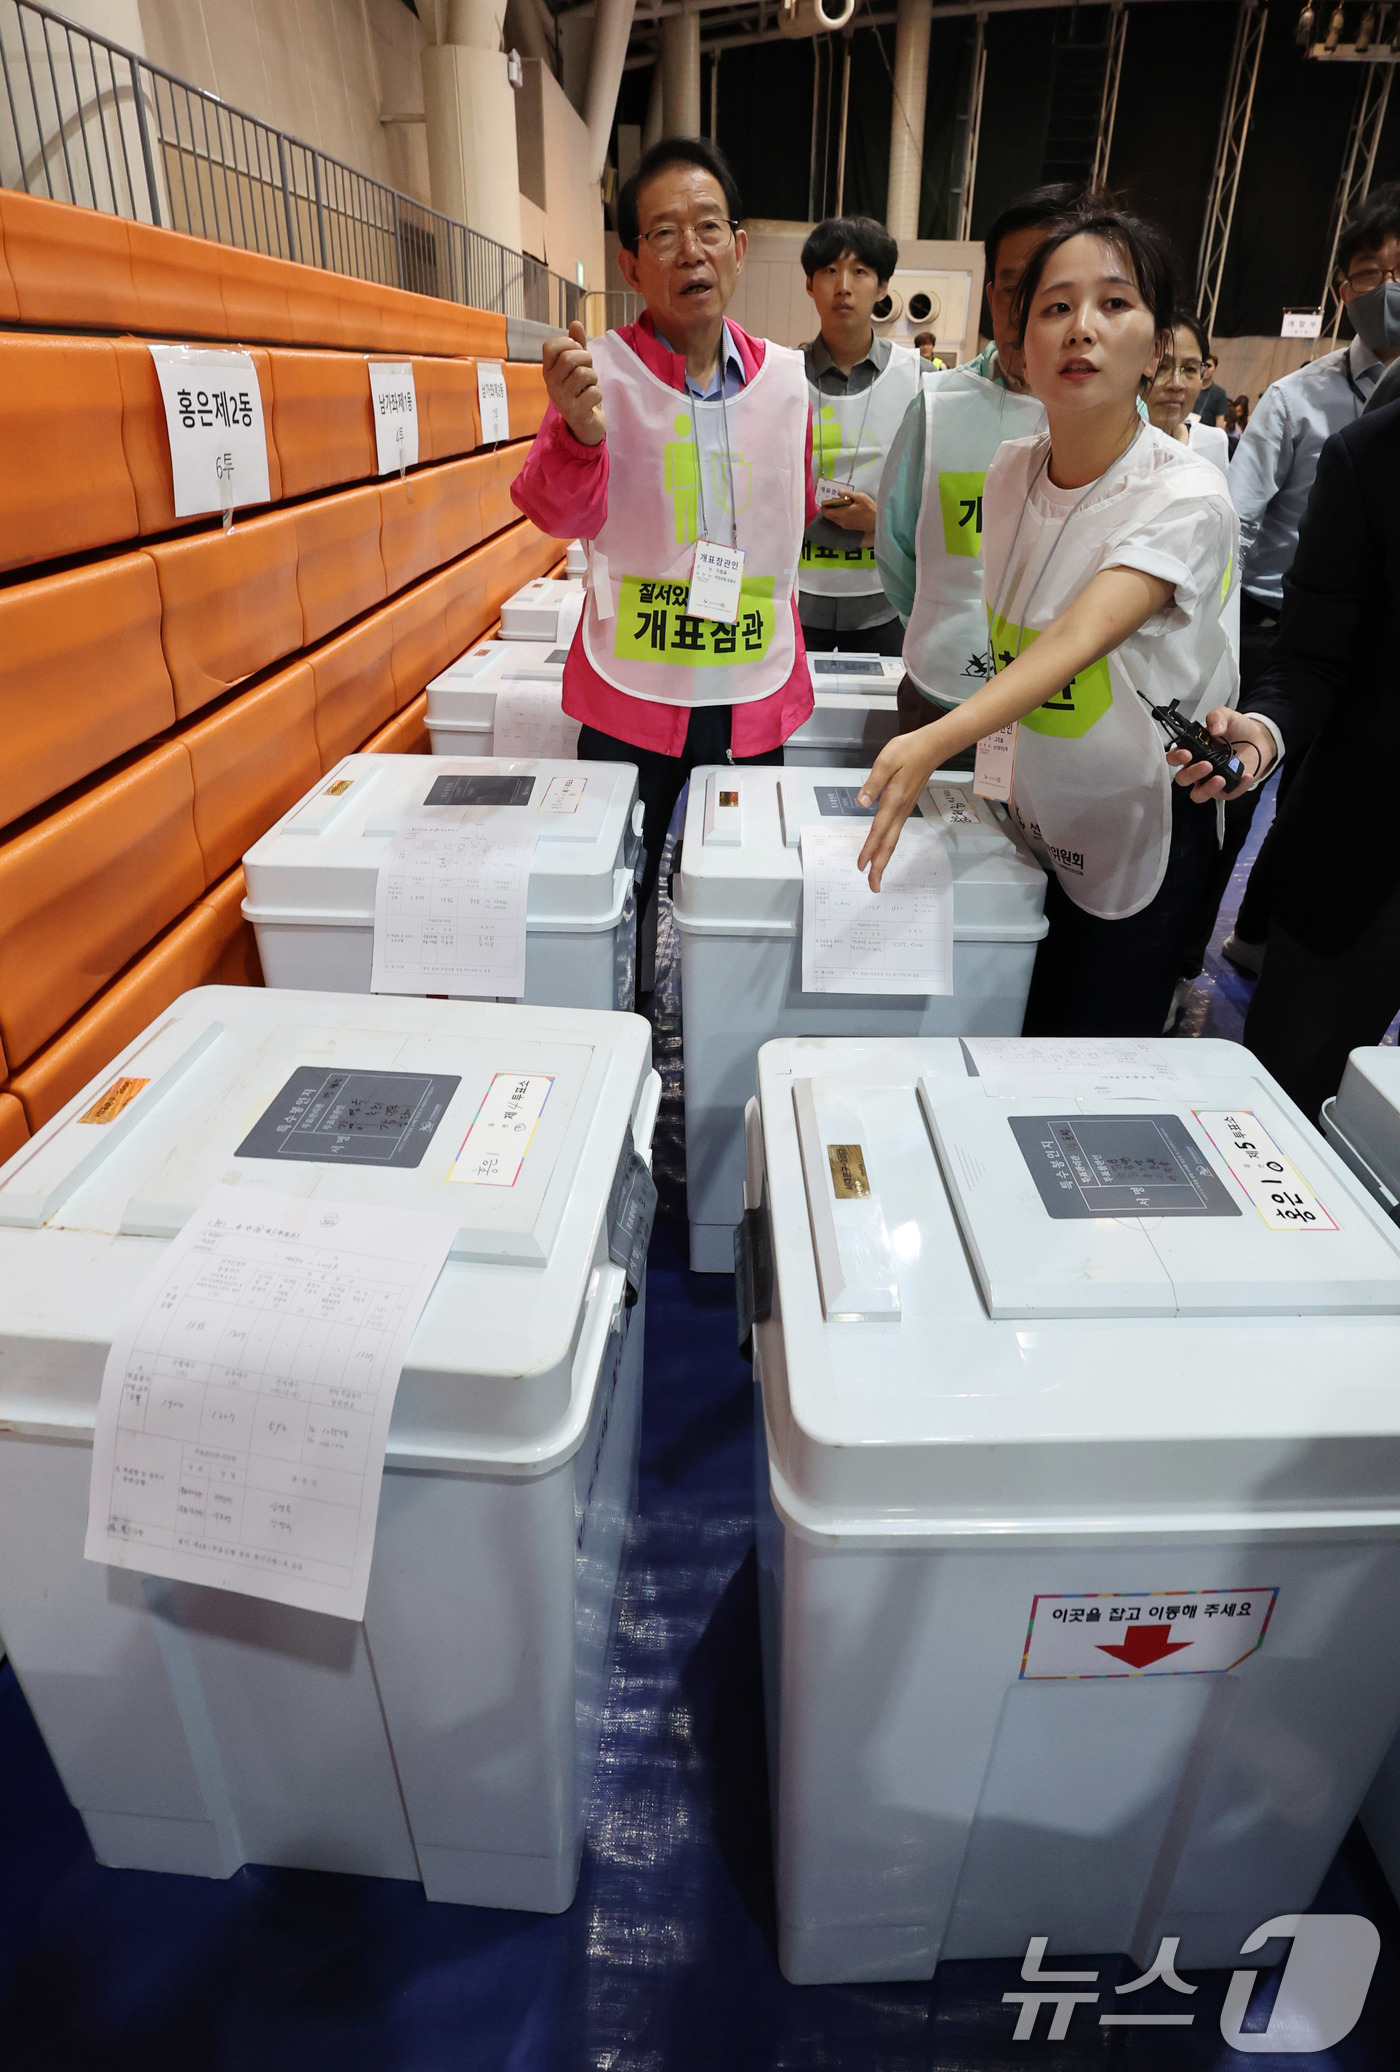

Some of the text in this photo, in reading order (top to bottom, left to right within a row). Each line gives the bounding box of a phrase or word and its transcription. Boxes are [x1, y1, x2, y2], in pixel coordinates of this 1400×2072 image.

[177, 388, 253, 429] 홍은제2동
[378, 391, 412, 415] 남가좌제1동
[215, 453, 235, 481] 6투
[819, 486, 838, 496] 개표참
[700, 553, 739, 571] 개표참관인
[639, 583, 690, 607] 질서있
[276, 1088, 317, 1133] 특수봉인지
[1040, 1141, 1074, 1189] 특수봉인지
[1052, 1602, 1252, 1623] 이곳을 잡고 이동해 주세요
